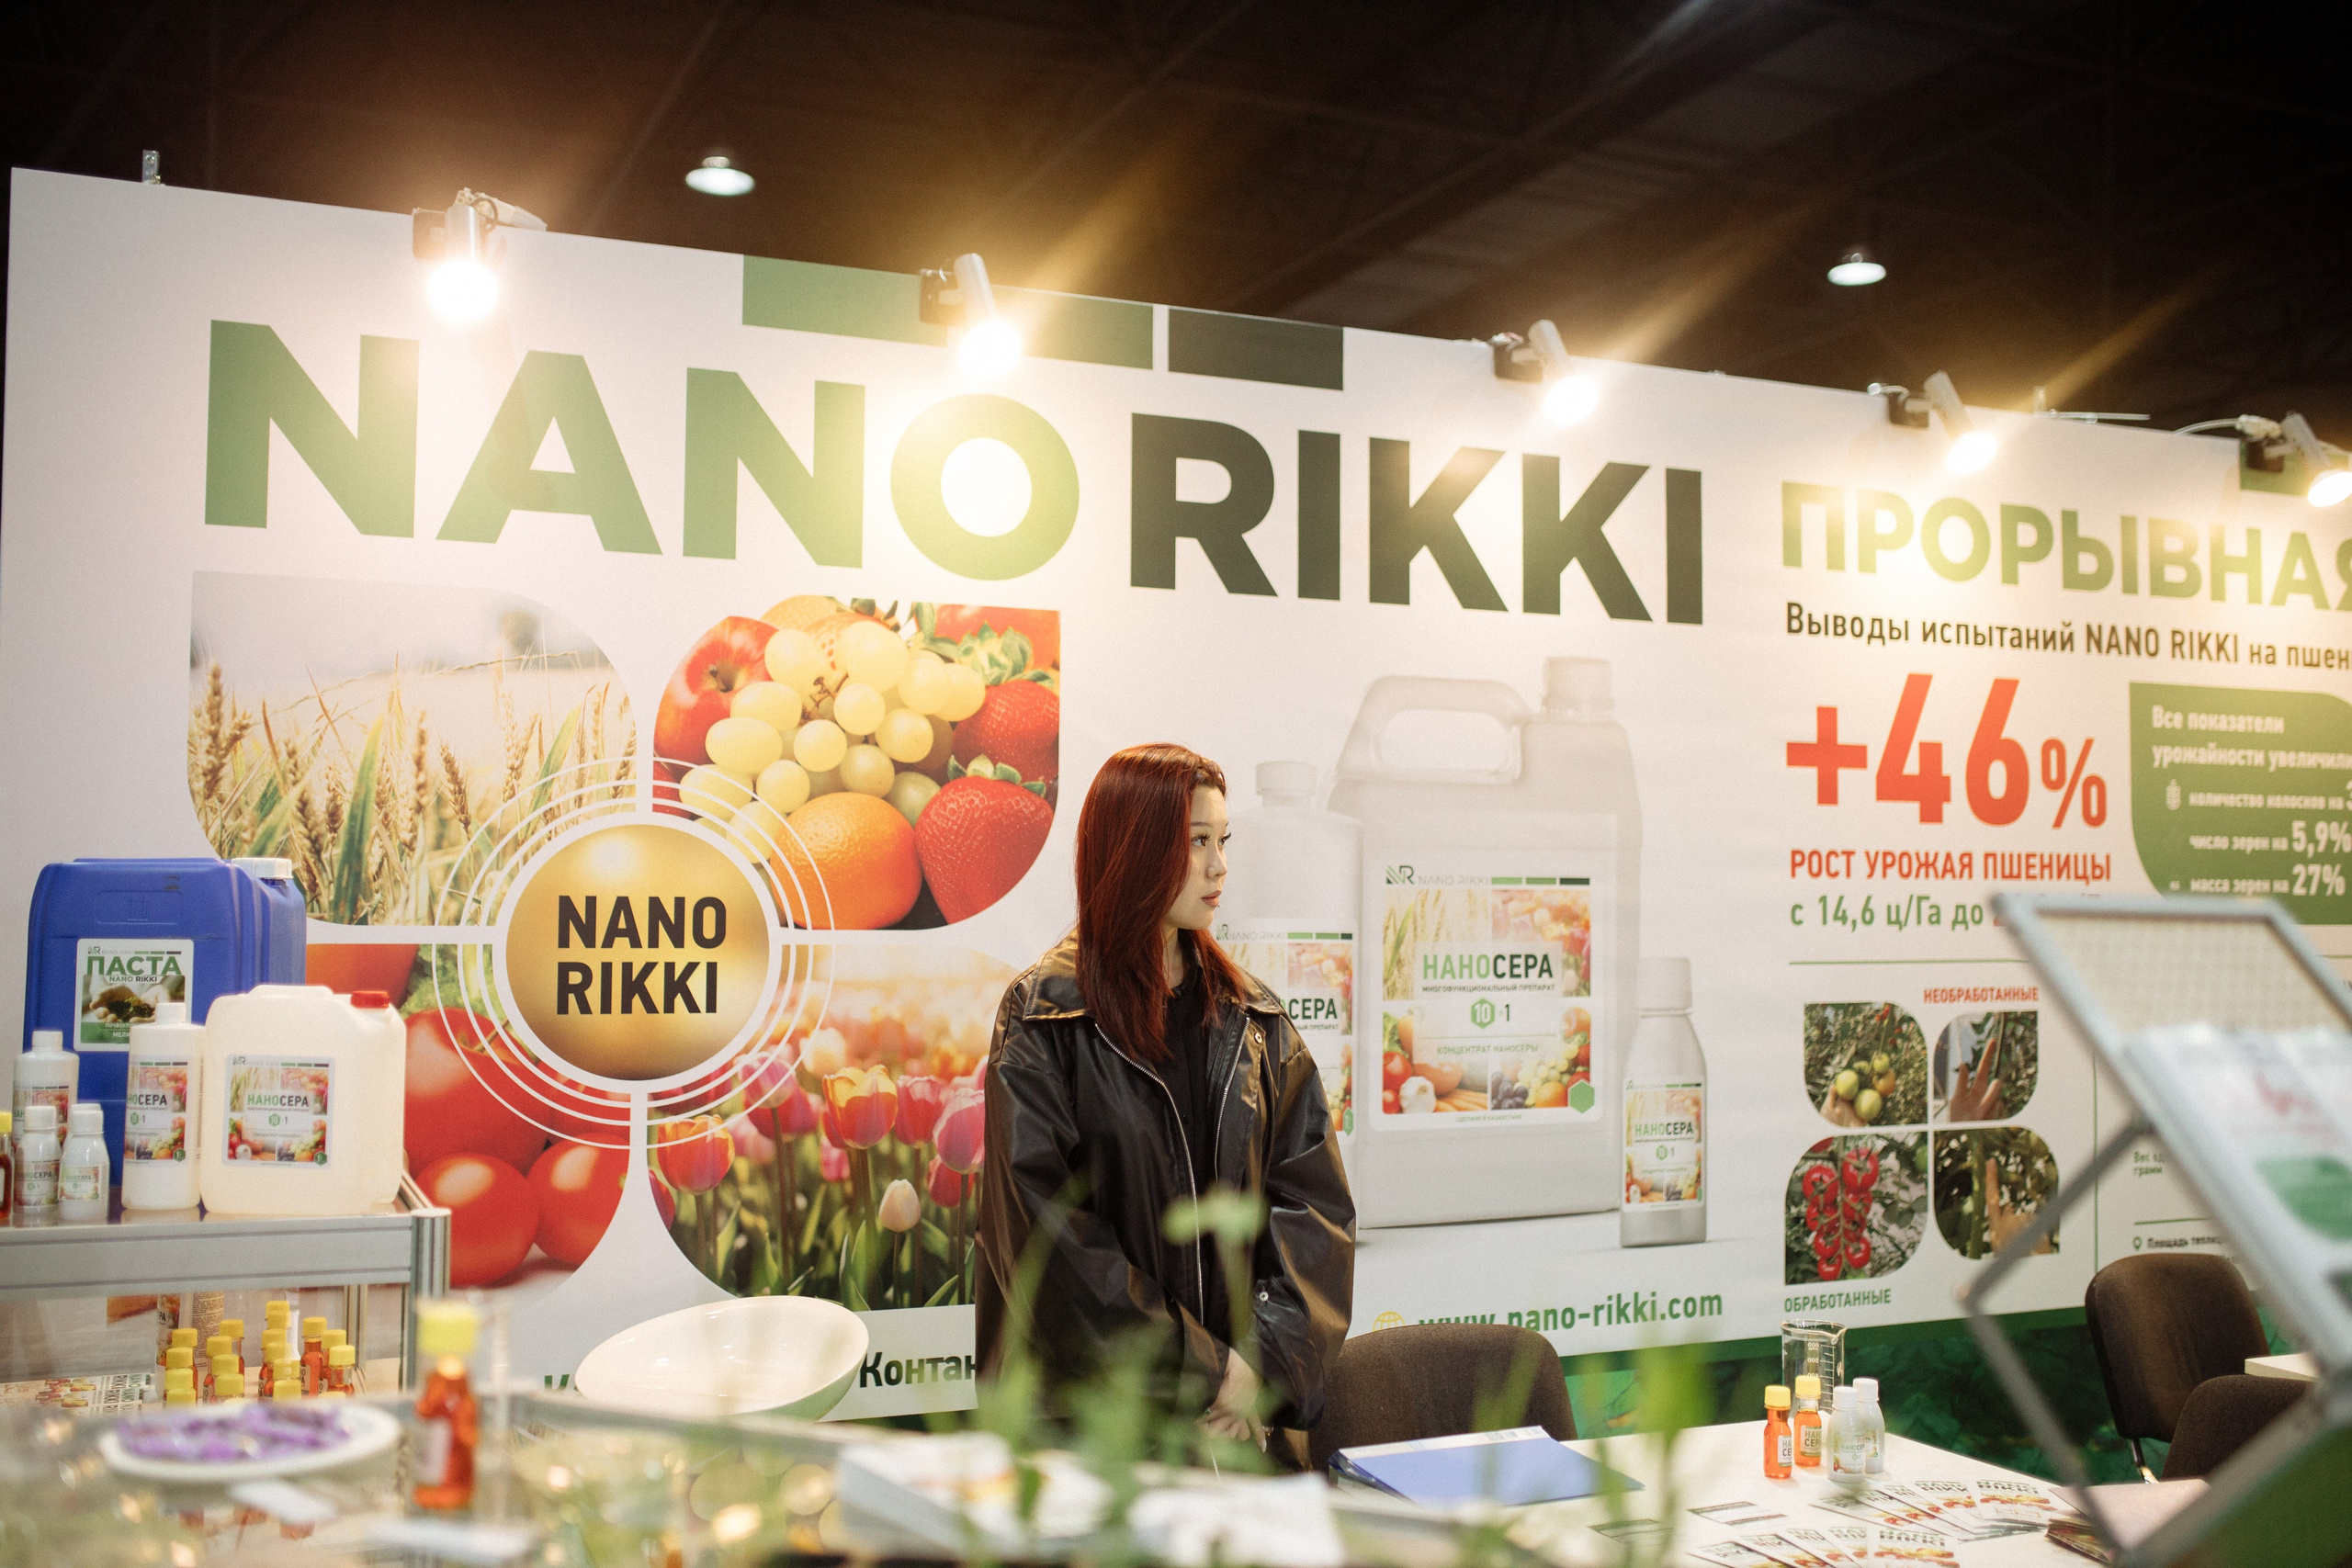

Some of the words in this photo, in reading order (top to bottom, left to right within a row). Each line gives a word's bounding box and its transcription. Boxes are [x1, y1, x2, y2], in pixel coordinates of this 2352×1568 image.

[205, 319, 1080, 581] NANO
[1130, 412, 1703, 626] RIKKI
[1787, 602, 1909, 646] Выводы
[1922, 620, 2075, 652] испытаний
[2086, 624, 2159, 658] NANO
[2171, 629, 2238, 662] RIKKI
[2250, 644, 2276, 665] на
[2152, 705, 2183, 729] Все
[2188, 712, 2285, 734] показатели
[1786, 672, 2107, 829] +46%
[2152, 741, 2266, 769] урожайности
[2189, 835, 2230, 851] число
[2271, 837, 2289, 851] на
[2291, 820, 2352, 858] 5,9%
[1791, 850, 1856, 879] РОСТ
[1864, 851, 1974, 880] УРОЖАЯ
[1983, 852, 2111, 886] ПШЕНИЦЫ
[2190, 878, 2231, 893] масса
[2272, 880, 2290, 893] на
[2291, 863, 2346, 896] 27%
[558, 895, 727, 949] NANO
[1791, 903, 1804, 926] с
[1818, 894, 1875, 931] 14,6
[1886, 894, 1942, 931] ц/Га
[1951, 903, 1984, 931] до
[86, 956, 182, 976] ПАСТА
[1422, 953, 1554, 980] НАНОСЕРА
[557, 961, 718, 1015] RIKKI
[1422, 984, 1517, 993] МНОГОФУНКЦИОНАЛЬНЫЙ
[1519, 983, 1555, 992] ПРЕПАРАТ
[1923, 987, 2040, 1004] НЕОБРАБОТАННЫЕ
[1474, 1002, 1491, 1023] 10
[1504, 1004, 1510, 1022] 1
[1437, 1044, 1491, 1055] КОНЦЕНТРАТ
[1493, 1043, 1539, 1054] НАНОСЕРЫ
[246, 1093, 310, 1108] НАНОСЕРА
[1634, 1122, 1694, 1137] НАНОСЕРА
[1419, 1291, 1723, 1332] nano-rikki.com
[1784, 1288, 1892, 1313] ОБРАБОТАННЫЕ
